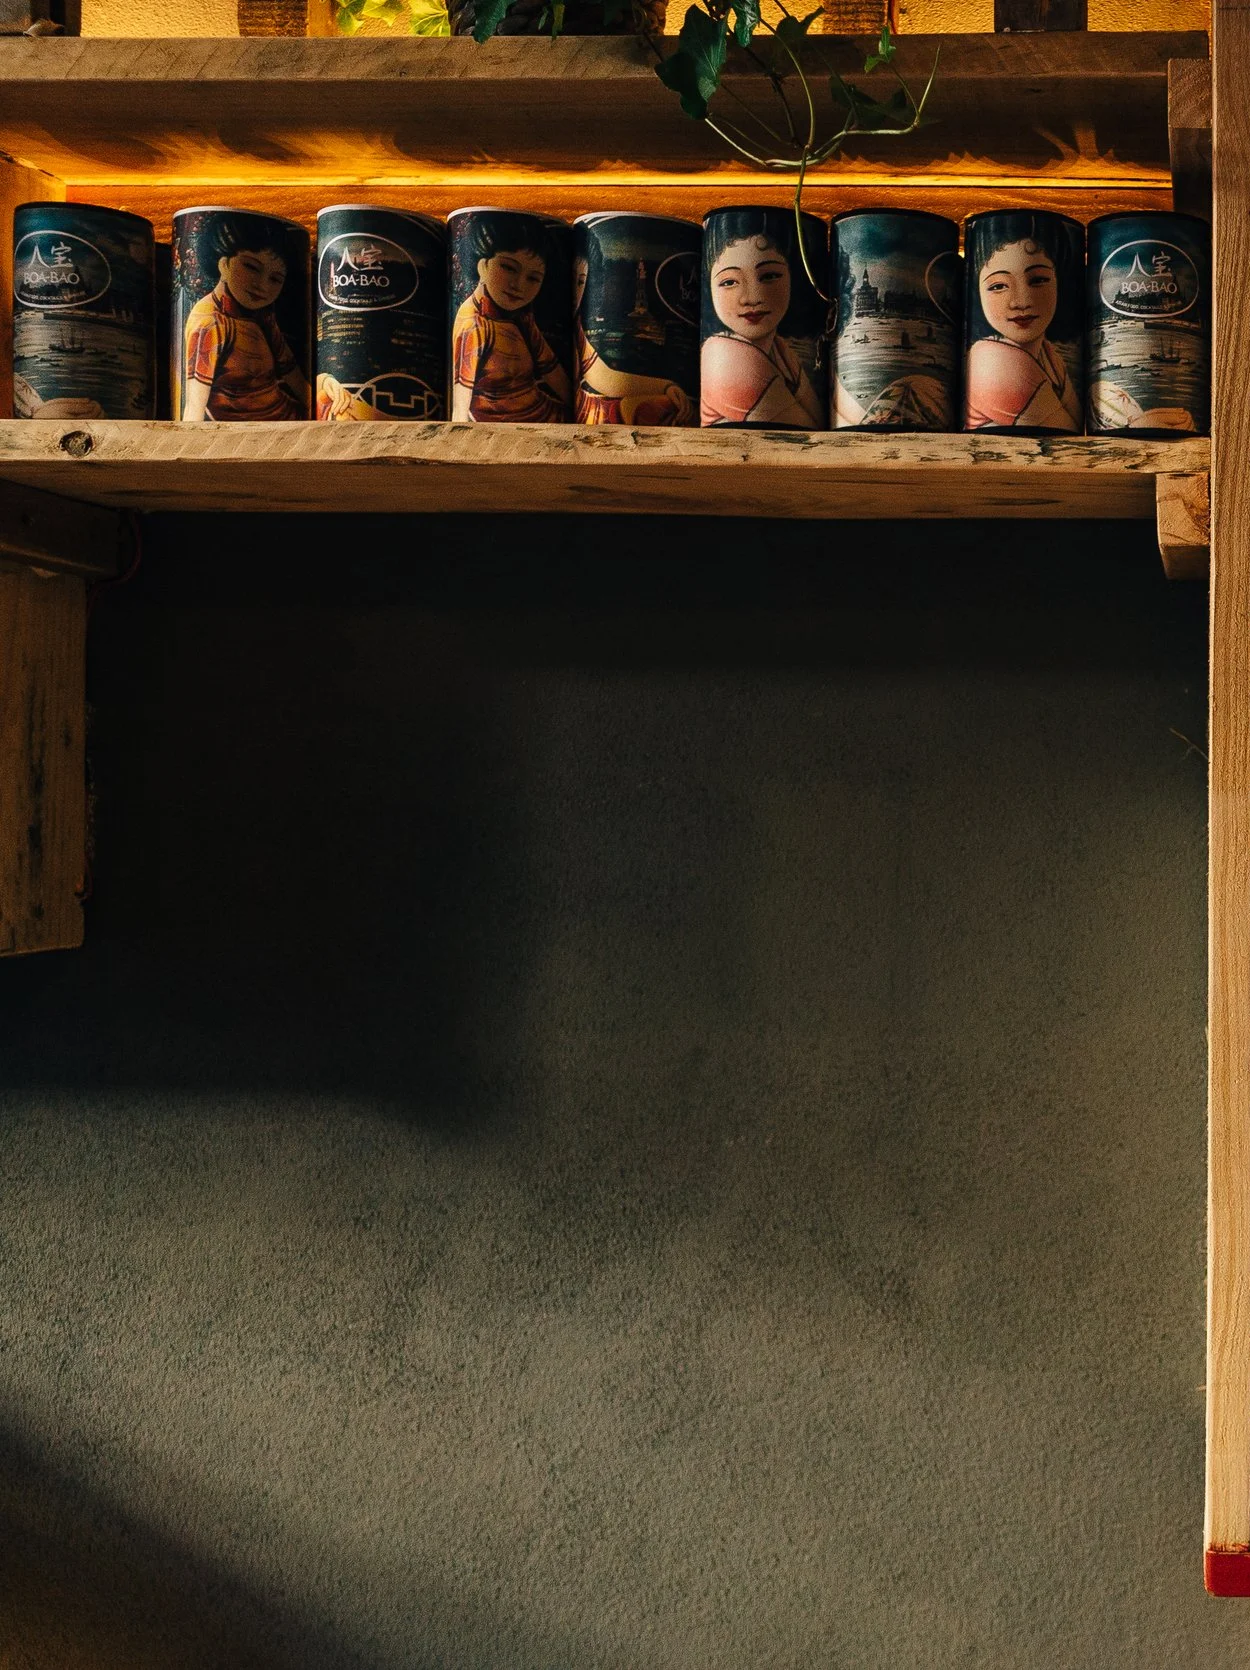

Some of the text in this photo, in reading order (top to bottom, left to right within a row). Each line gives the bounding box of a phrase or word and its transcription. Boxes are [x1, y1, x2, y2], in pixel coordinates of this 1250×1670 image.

[24, 271, 80, 285] BOA-BAO
[333, 274, 390, 287] BOA-BAO
[1122, 281, 1178, 294] BOA-BAO
